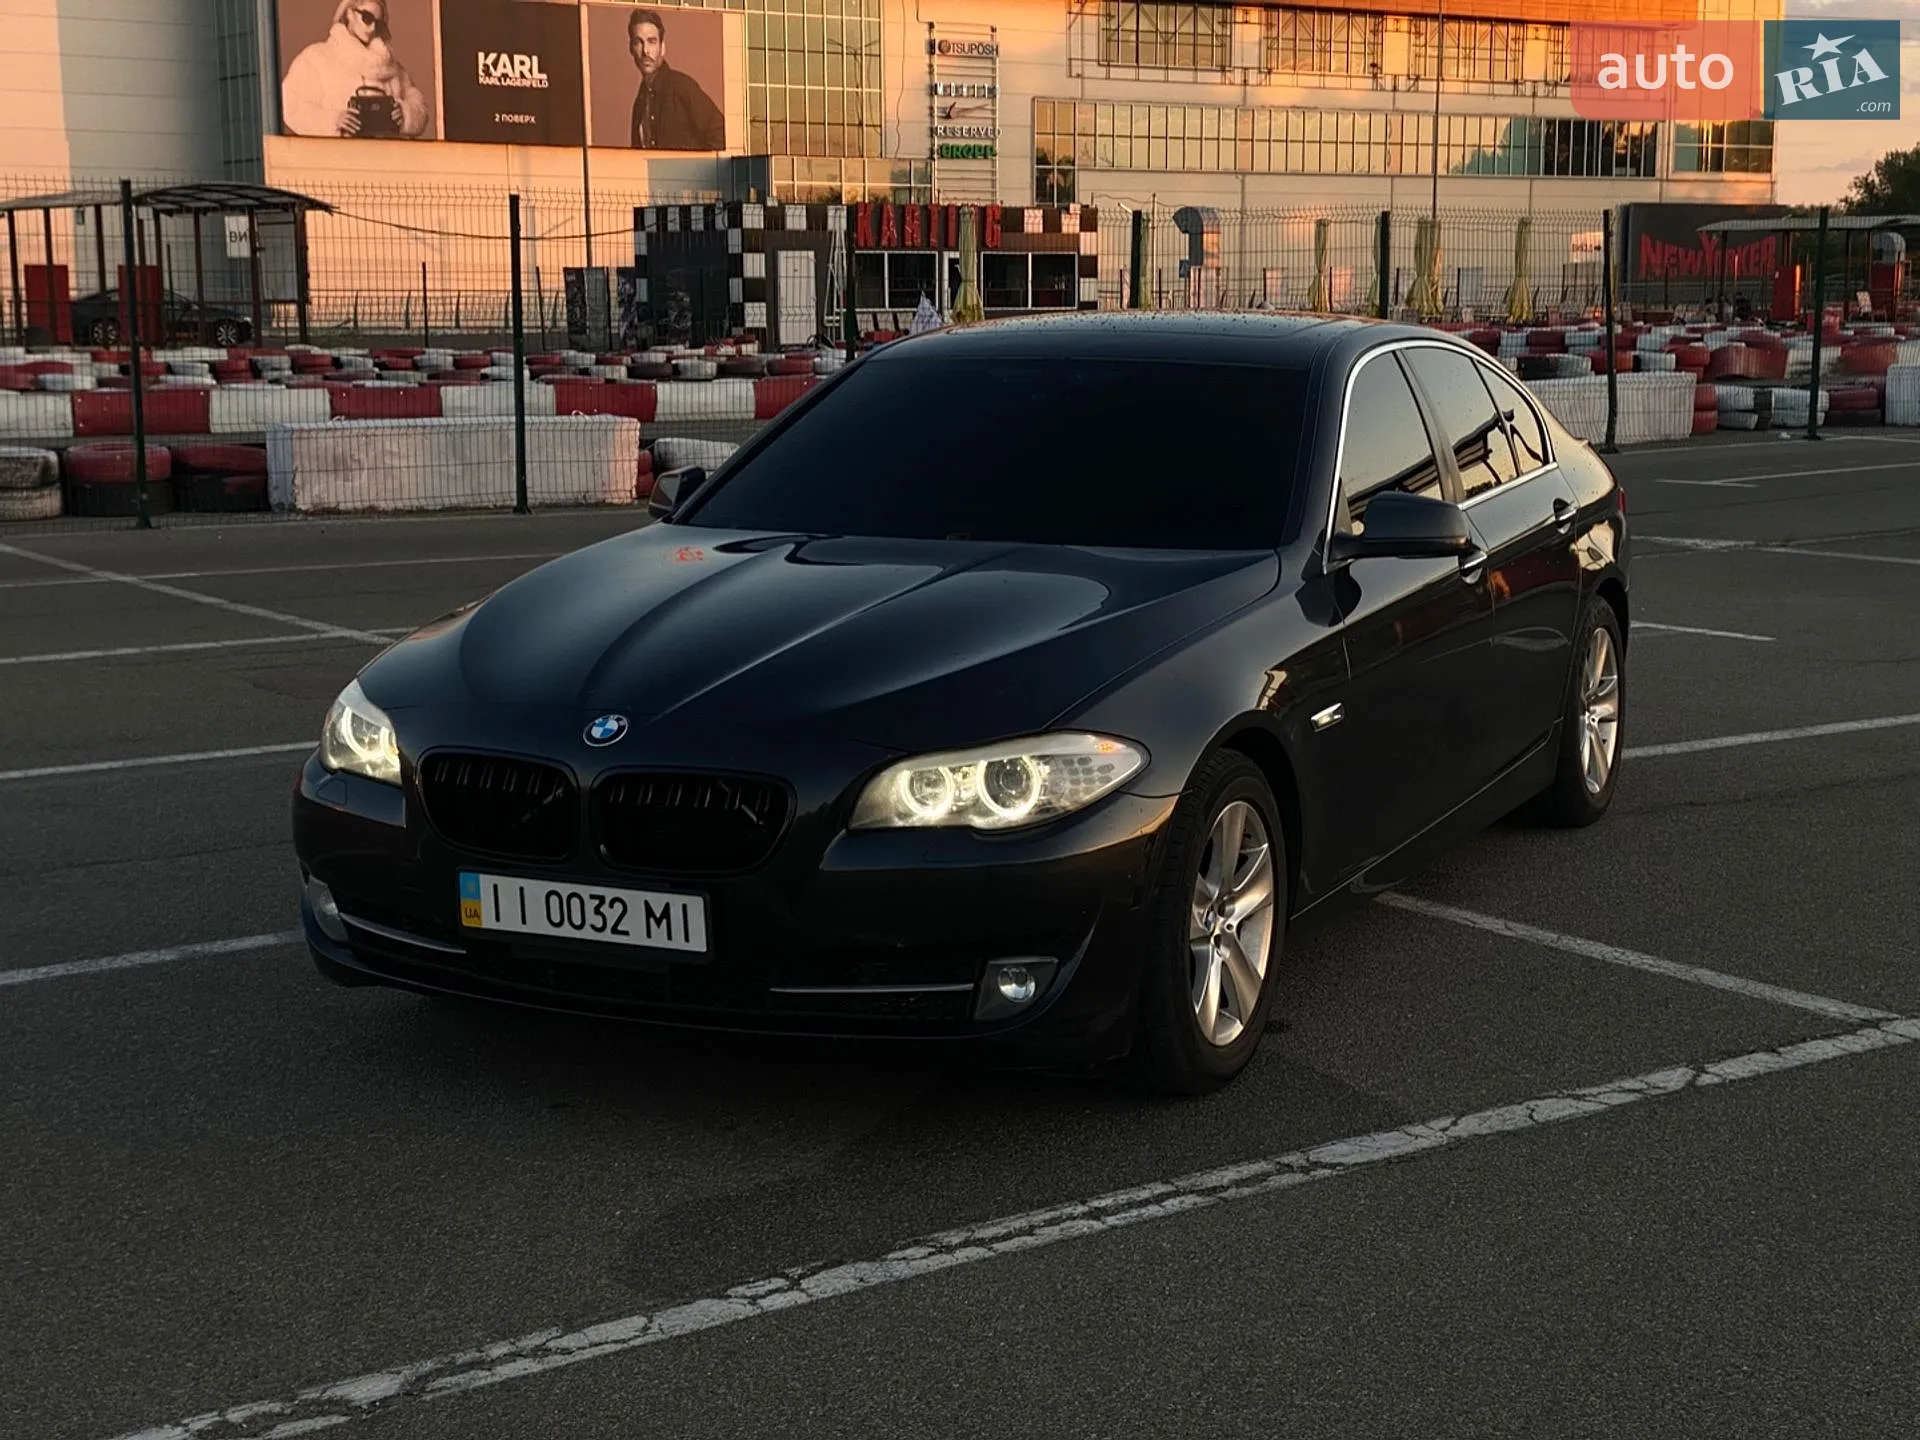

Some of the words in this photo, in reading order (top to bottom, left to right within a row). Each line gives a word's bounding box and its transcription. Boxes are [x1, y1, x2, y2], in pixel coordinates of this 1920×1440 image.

[478, 51, 548, 80] KARL
[494, 112, 501, 122] 2
[501, 113, 537, 124] ПОВЕРХ
[936, 124, 1003, 138] RESERVED
[855, 202, 1001, 248] KARTIG
[464, 906, 481, 920] UA
[544, 889, 630, 936] 0032
[643, 899, 691, 943] MI
